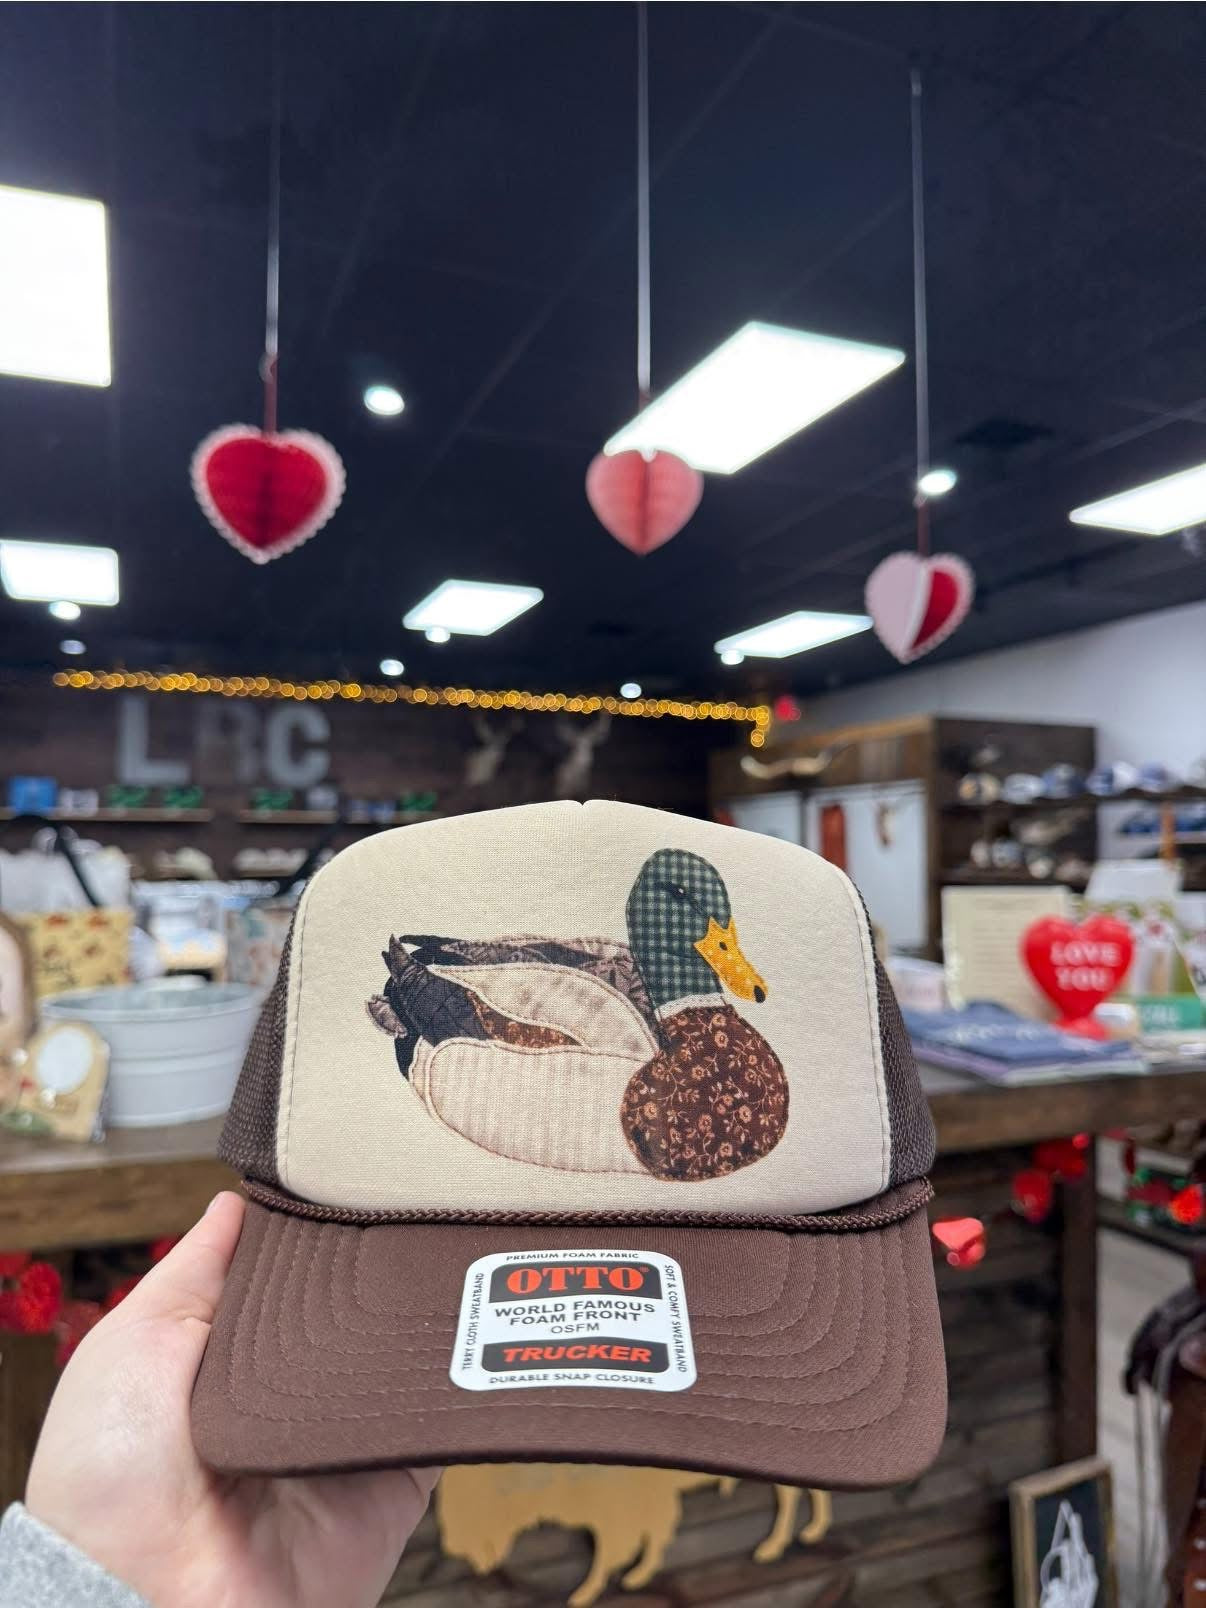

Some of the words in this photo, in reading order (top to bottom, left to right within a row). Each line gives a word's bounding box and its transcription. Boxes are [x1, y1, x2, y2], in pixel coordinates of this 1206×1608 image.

[1051, 940, 1122, 967] LOVE
[1056, 966, 1114, 992] YOU
[506, 1252, 559, 1261] PREMIUM
[562, 1251, 597, 1259] FOAM
[506, 1266, 645, 1295] OTTO
[664, 1264, 676, 1281] SOFT
[470, 1272, 485, 1320] SWEATBAND
[668, 1290, 681, 1319] COMFY
[494, 1302, 566, 1317] WORLD
[573, 1300, 656, 1313] FAMOUS
[509, 1313, 566, 1326] FOAM
[573, 1310, 641, 1322] FRONT
[466, 1321, 479, 1346] CLOTH
[550, 1322, 600, 1334] OSFM
[503, 1343, 652, 1364] TRUCKER
[671, 1320, 688, 1373] SWEATBAND
[462, 1347, 476, 1370] TERRY
[489, 1373, 549, 1384] DURABLE
[553, 1373, 591, 1381] SNAP
[595, 1373, 655, 1385] CLOSURE
